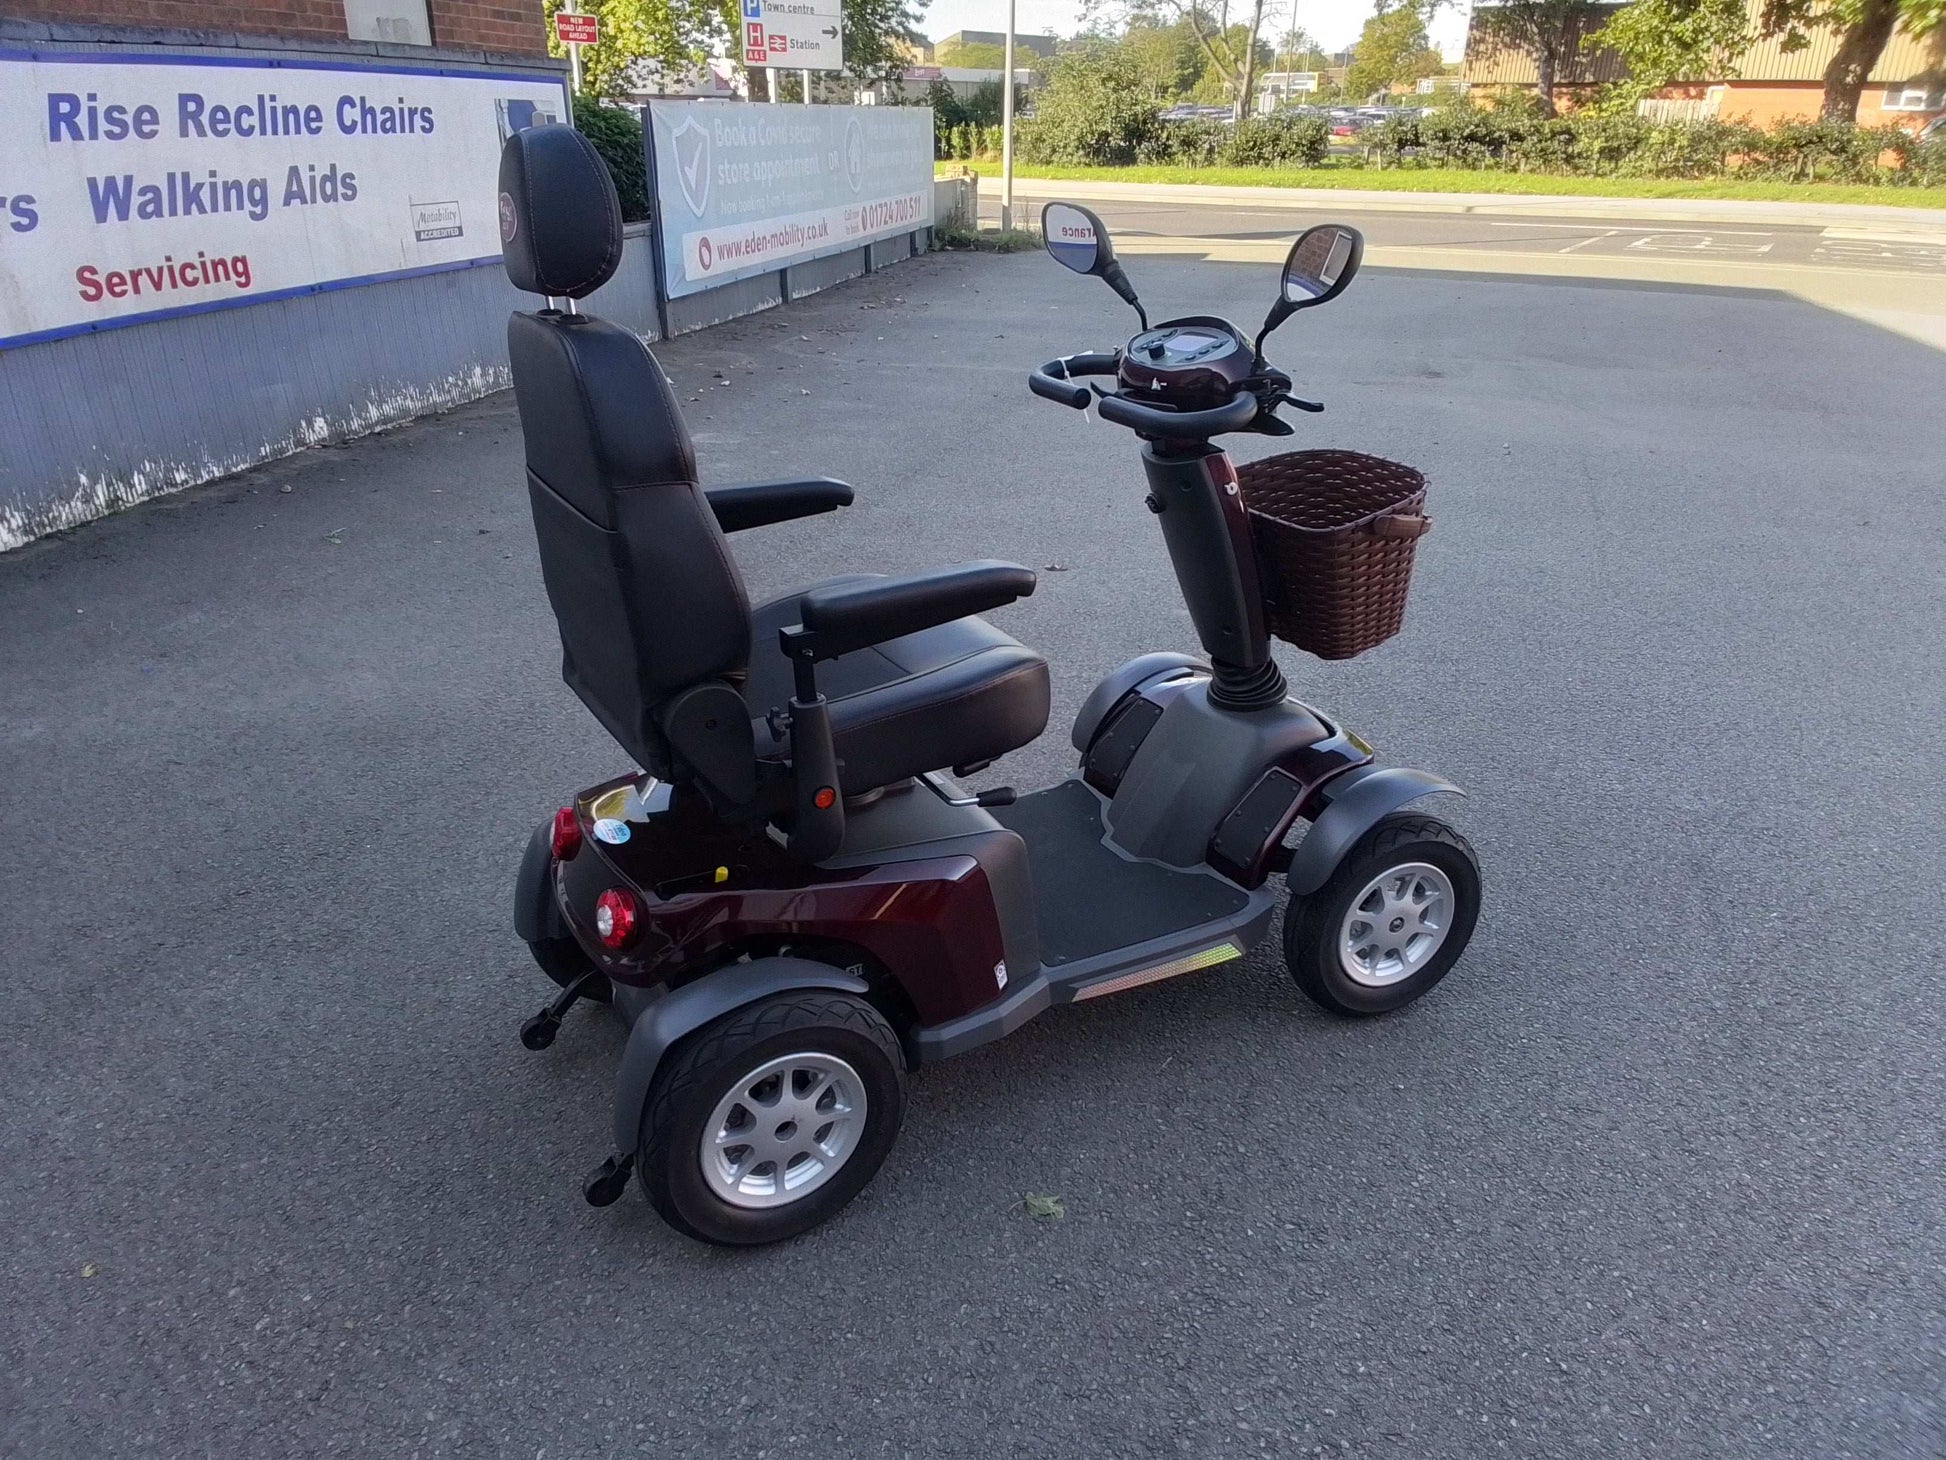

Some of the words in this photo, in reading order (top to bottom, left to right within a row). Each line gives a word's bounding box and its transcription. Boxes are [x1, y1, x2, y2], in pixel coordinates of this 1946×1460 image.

[763, 0, 785, 12] Town
[788, 4, 815, 15] centre
[576, 25, 595, 33] LAYOUT
[750, 24, 762, 45] H
[790, 39, 820, 50] Station
[748, 51, 765, 60] A&E
[47, 92, 160, 142] Rise
[178, 93, 323, 139] Recline
[336, 95, 434, 135] Chairs
[714, 117, 747, 148] Book
[758, 116, 788, 146] Covid
[717, 158, 750, 185] store
[753, 152, 821, 188] appointment
[828, 150, 840, 171] OR
[86, 170, 269, 225] Walking
[282, 163, 358, 208] Aids
[418, 207, 457, 228] Motability
[868, 201, 895, 231] 01724
[895, 198, 909, 222] 700
[909, 195, 921, 219] 511
[420, 229, 460, 240] ACCREDITED
[717, 216, 830, 261] www.eden-mobility.co.uk
[75, 250, 252, 301] Servicing
